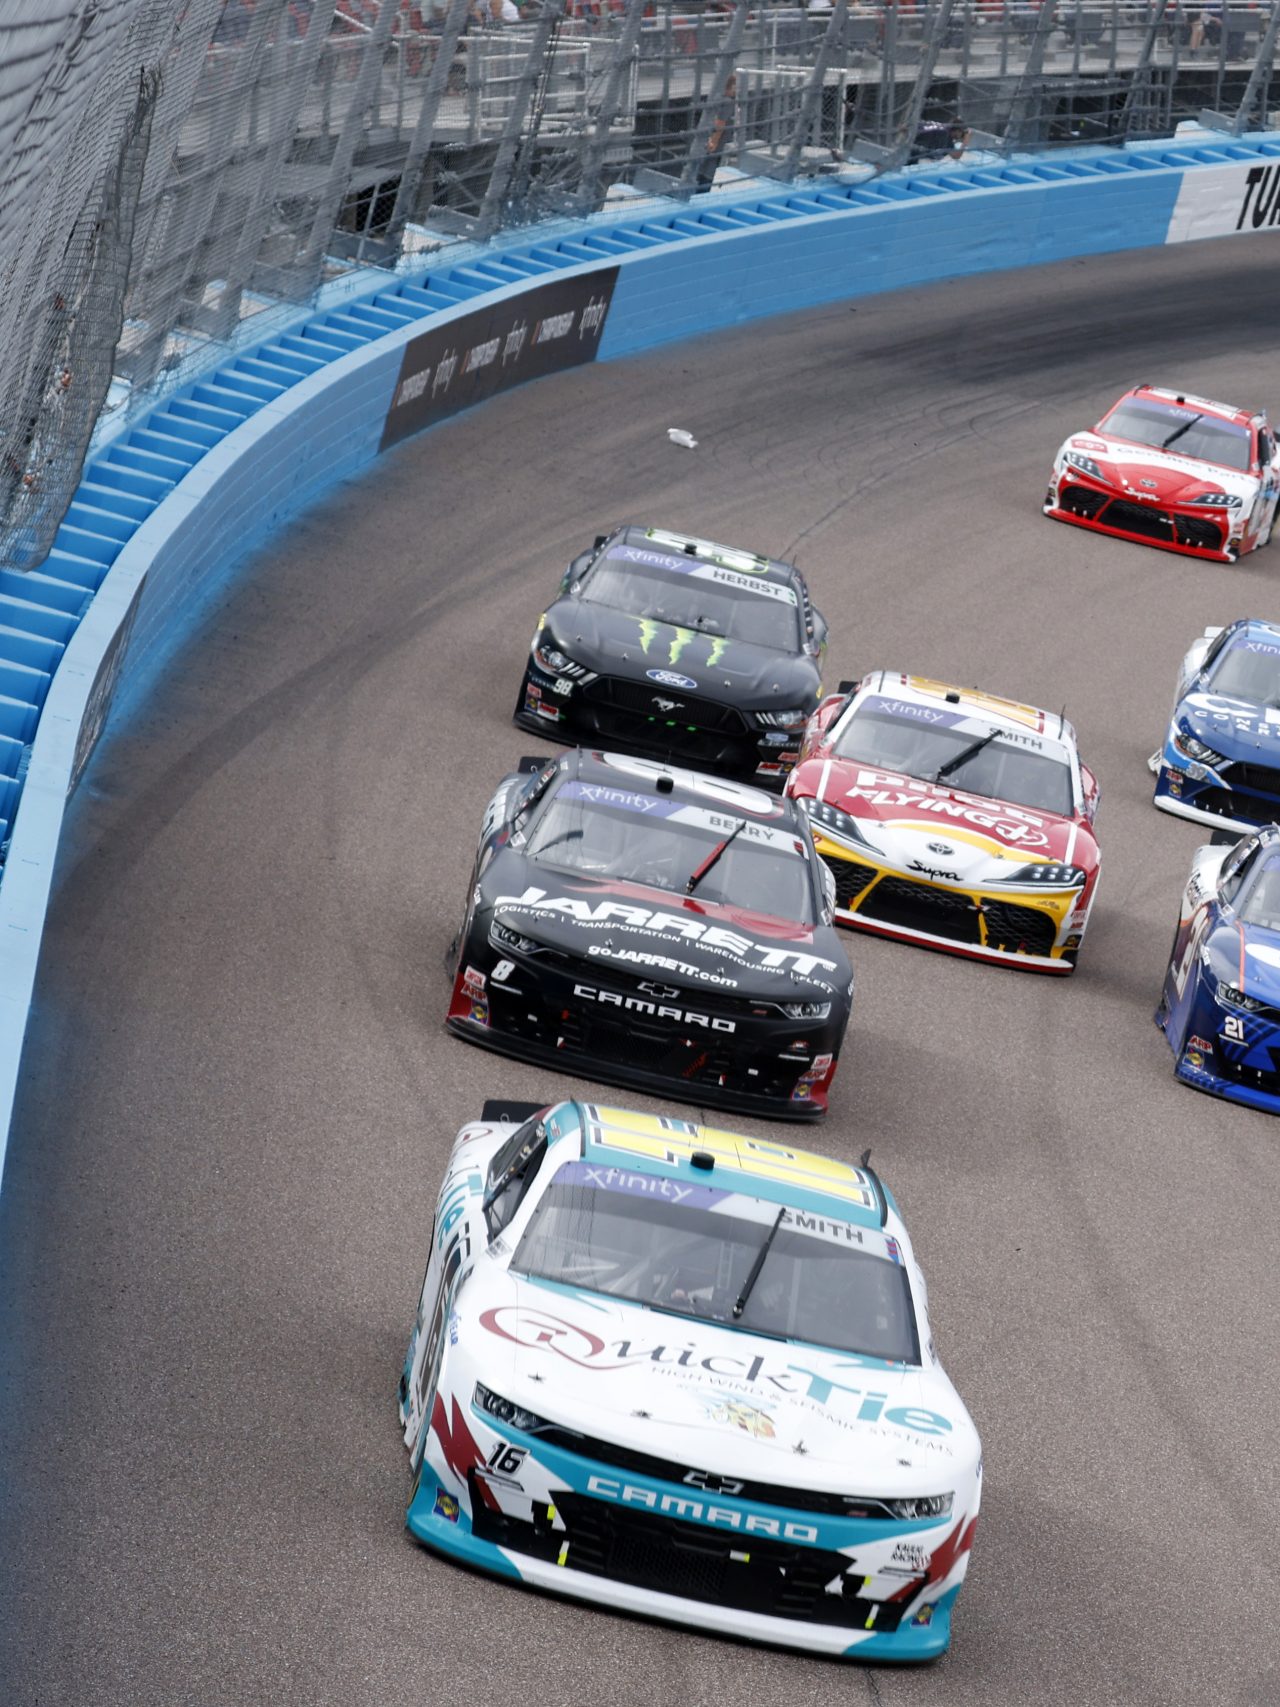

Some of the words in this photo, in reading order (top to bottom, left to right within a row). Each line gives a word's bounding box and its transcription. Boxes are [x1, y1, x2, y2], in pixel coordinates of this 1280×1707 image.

[624, 549, 685, 575] xfinity
[712, 570, 782, 596] HERBST
[553, 677, 573, 696] 98
[654, 671, 688, 687] Ford
[878, 700, 945, 724] xfinity
[579, 786, 659, 812] xfinity
[846, 786, 1000, 828] FLYING
[709, 815, 775, 841] BERRY
[905, 860, 964, 882] Supra
[494, 886, 838, 977] JARRETT
[494, 904, 556, 918] LOGISTICS
[570, 919, 681, 943] TRANSPORTATION
[695, 942, 785, 976] WAREHOUSING
[798, 974, 834, 995] FLEET
[490, 959, 516, 981] 8
[588, 945, 738, 988] goJARRETT.com
[573, 983, 737, 1034] CAMARO
[1224, 1015, 1245, 1040] 21
[584, 1167, 693, 1203] xfinity
[779, 1210, 864, 1244] SMITH
[652, 1365, 702, 1383] HIGH
[708, 1376, 764, 1395] WIND
[486, 1440, 531, 1476] 16
[586, 1475, 819, 1543] CAMARO
